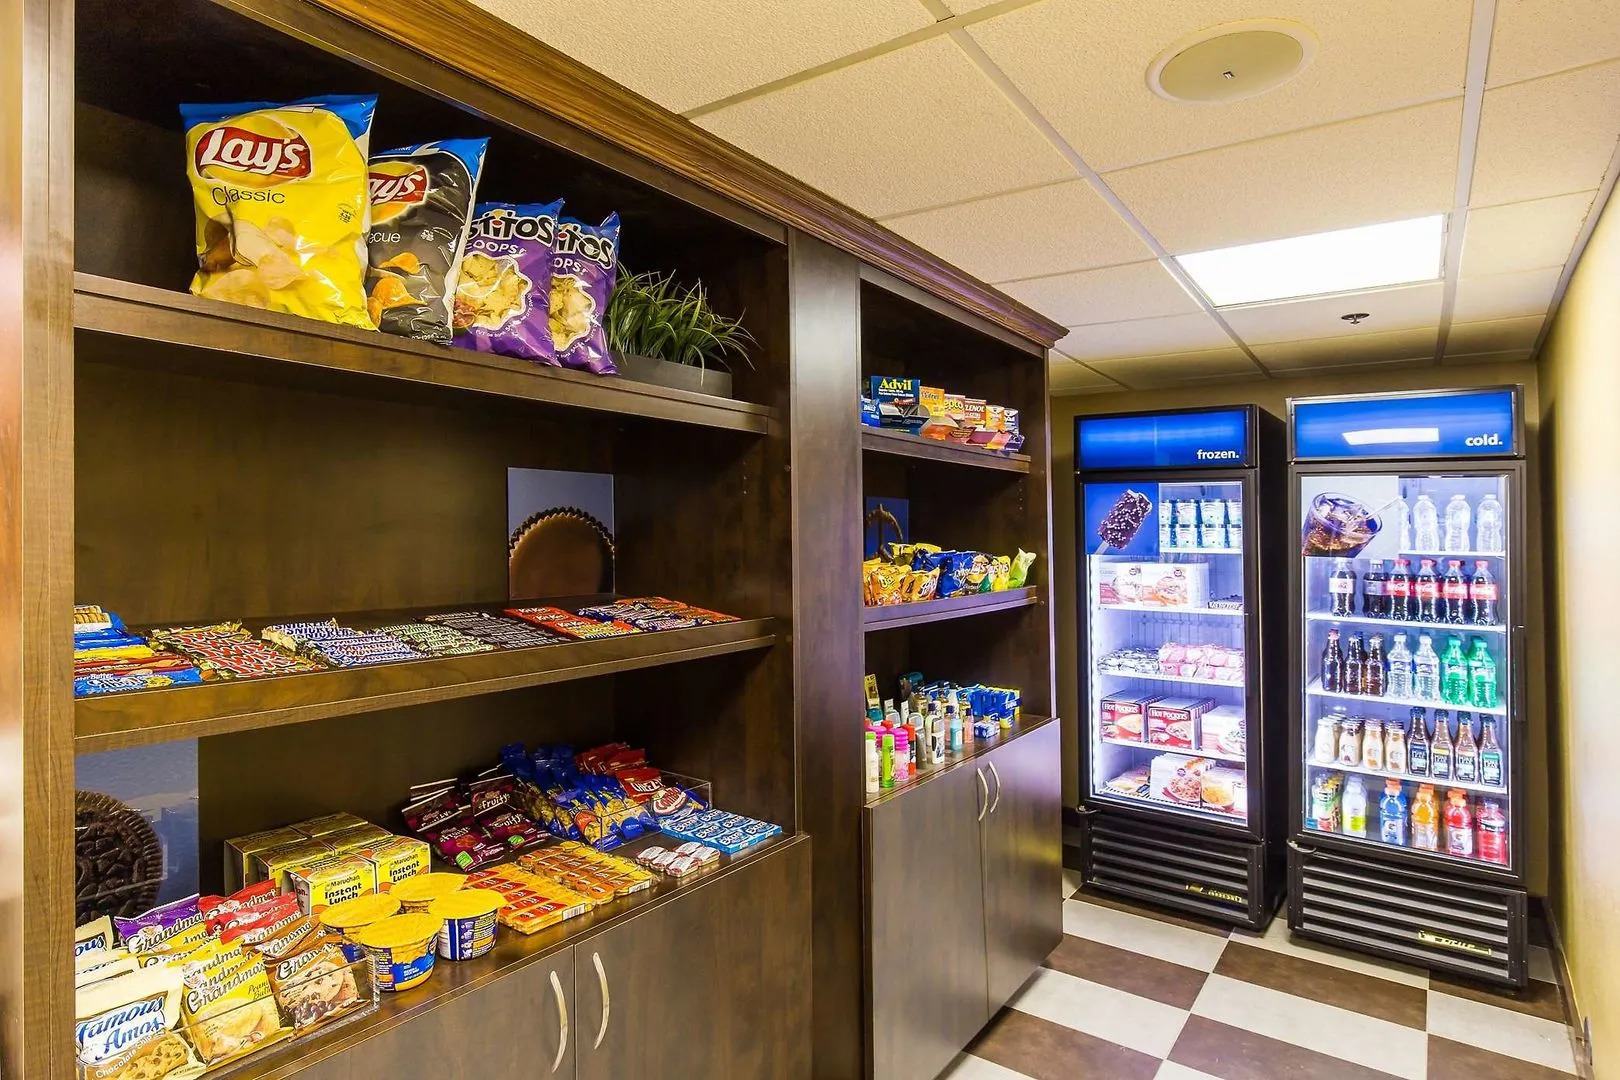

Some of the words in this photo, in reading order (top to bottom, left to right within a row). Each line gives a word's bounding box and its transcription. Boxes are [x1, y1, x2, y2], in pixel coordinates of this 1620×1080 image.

[200, 129, 307, 176] Lay's
[211, 186, 286, 206] Classic
[880, 378, 912, 390] Advil
[1465, 434, 1503, 446] cold.
[1197, 449, 1239, 459] frozen.
[389, 860, 420, 877] Instant
[392, 868, 417, 883] Lunch
[330, 875, 361, 888] Maruchan
[325, 882, 362, 899] Instant
[329, 892, 358, 905] Lunch
[79, 995, 164, 1048] Famous
[103, 1016, 164, 1054] Amos
